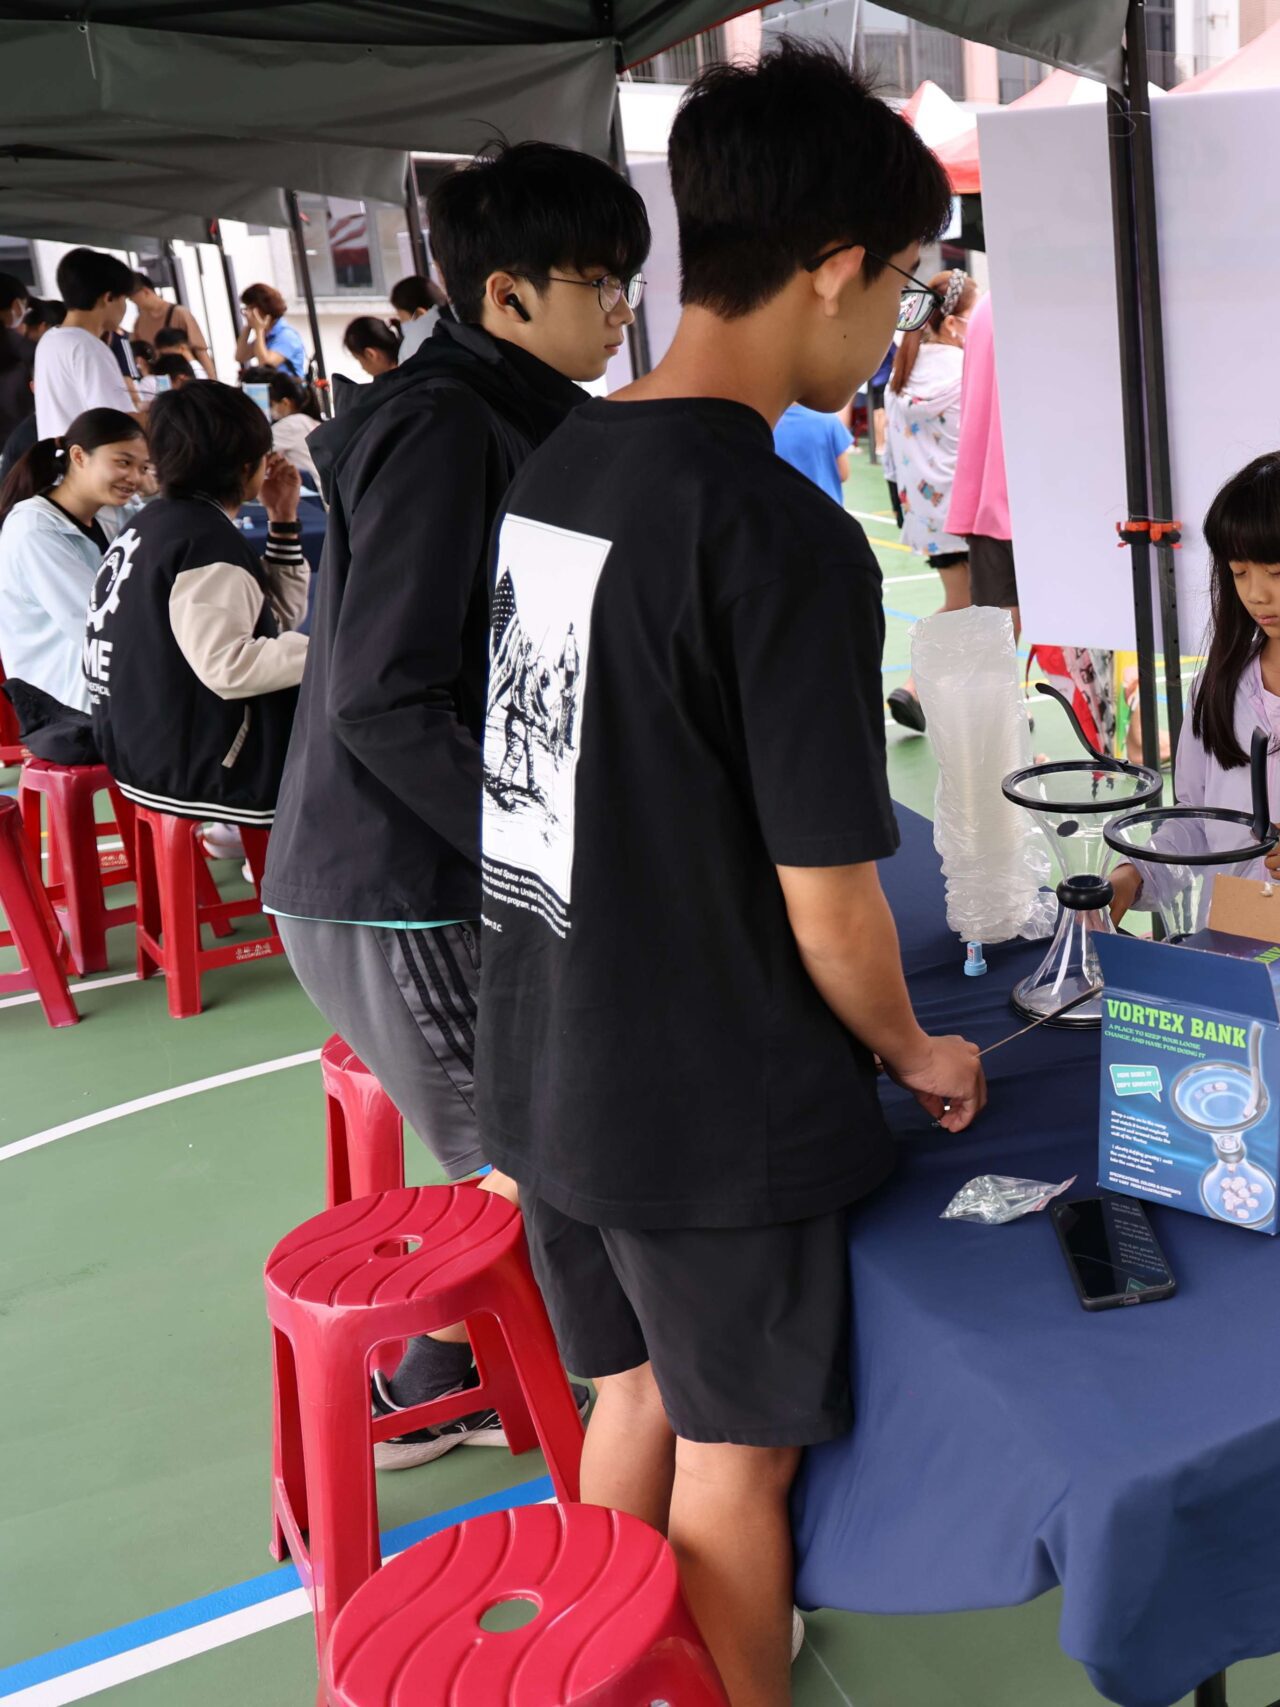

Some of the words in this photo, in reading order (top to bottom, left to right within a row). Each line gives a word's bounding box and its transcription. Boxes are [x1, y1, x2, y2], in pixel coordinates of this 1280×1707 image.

[503, 870, 519, 881] Space
[1107, 999, 1185, 1035] VORTEX
[1190, 1017, 1246, 1049] BANK
[1104, 1030, 1131, 1041] CHANGE
[1132, 1036, 1145, 1045] AND
[1145, 1040, 1162, 1049] HAVE
[1163, 1044, 1176, 1052] FUN
[1177, 1047, 1198, 1058] DOING
[1114, 1025, 1134, 1034] PLACE
[1135, 1029, 1144, 1037] TO
[1145, 1031, 1162, 1041] KEEP
[1162, 1034, 1179, 1045] YOUR
[1179, 1039, 1201, 1050] LOOSE
